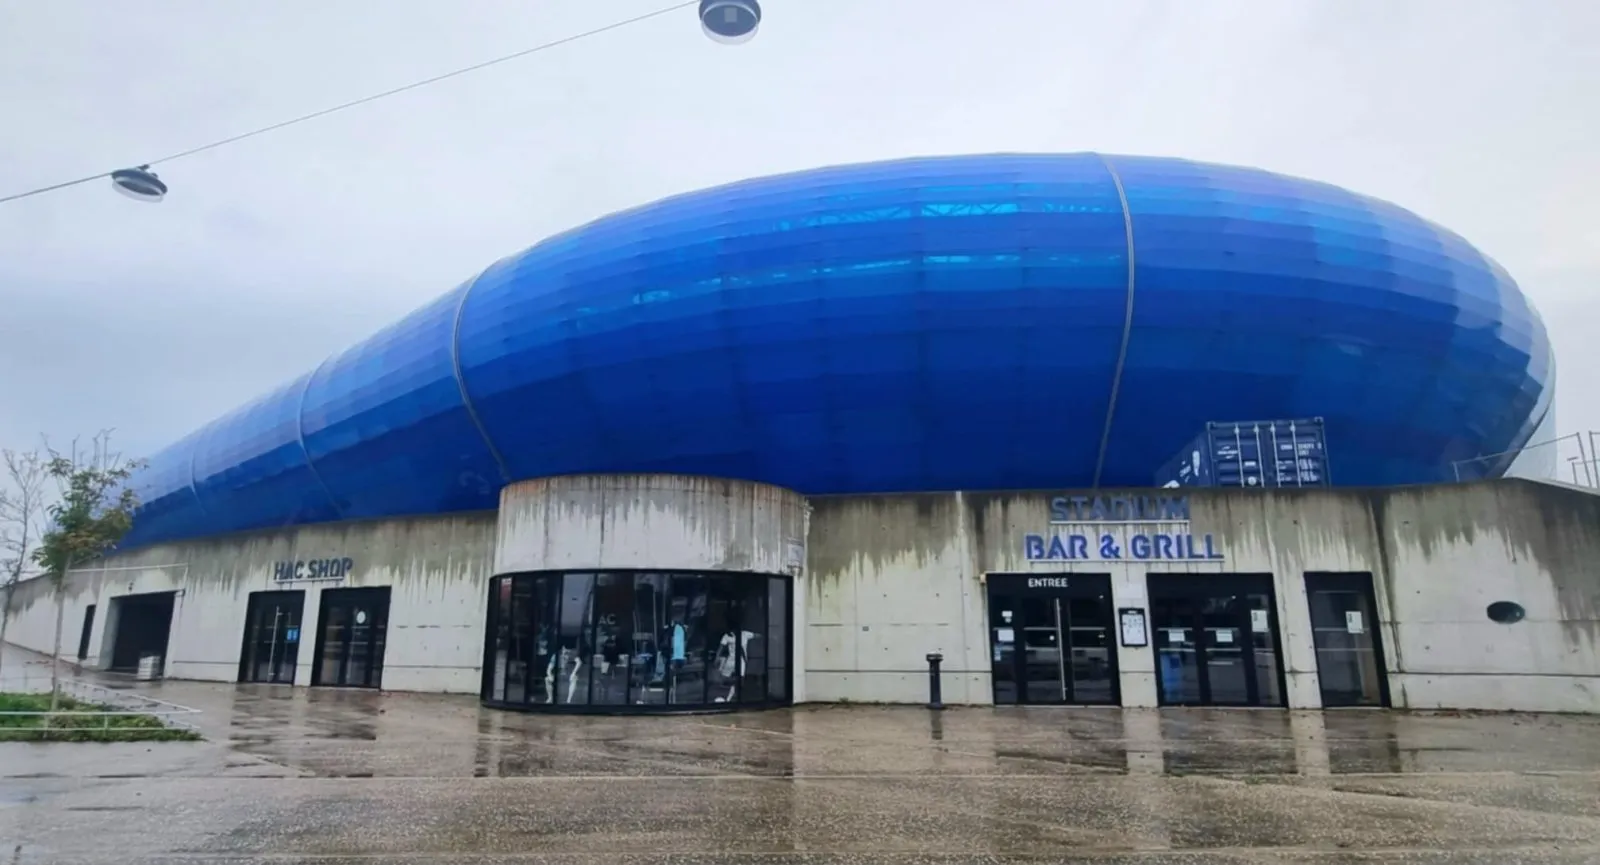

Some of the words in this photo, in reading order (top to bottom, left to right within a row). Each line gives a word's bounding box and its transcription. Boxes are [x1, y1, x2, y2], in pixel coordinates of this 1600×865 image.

[1050, 496, 1190, 521] STADIUM
[1026, 534, 1088, 560] BAR
[1100, 534, 1121, 559] &
[1131, 534, 1225, 560] GRILL
[274, 560, 305, 580] HAC
[307, 556, 353, 578] SHOP
[1028, 577, 1069, 588] ENTREE
